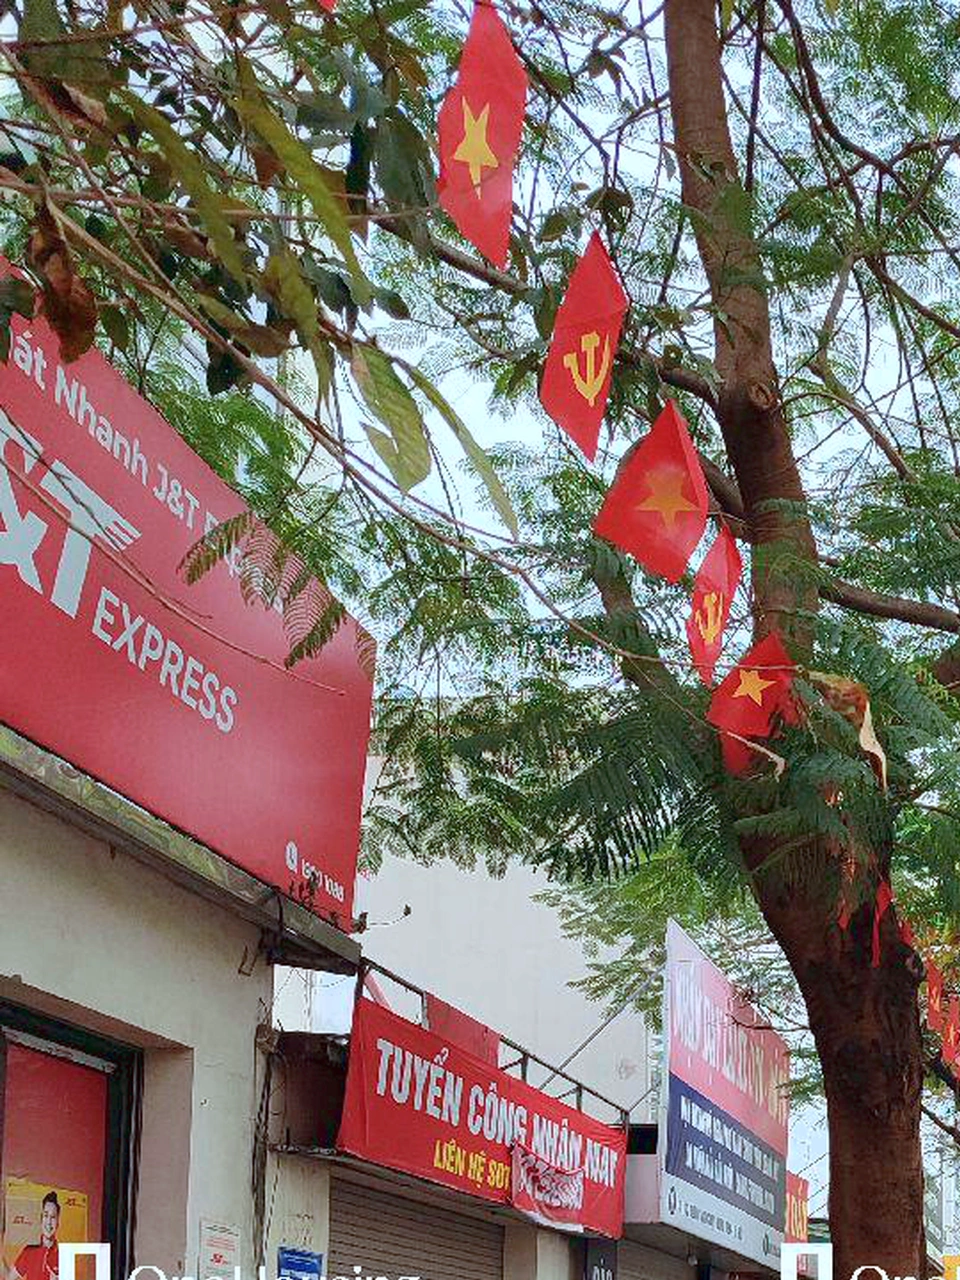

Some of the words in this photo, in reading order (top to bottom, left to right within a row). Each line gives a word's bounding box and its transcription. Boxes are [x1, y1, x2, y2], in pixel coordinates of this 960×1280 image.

[0, 404, 143, 620] &T
[9, 325, 47, 391] át
[55, 364, 148, 486] Nhanh
[152, 463, 200, 531] J&T
[91, 586, 238, 734] EXPRESS
[376, 1038, 464, 1127] TUYỂN
[467, 1081, 528, 1148] CÔNG
[531, 1117, 583, 1172] NHÂN
